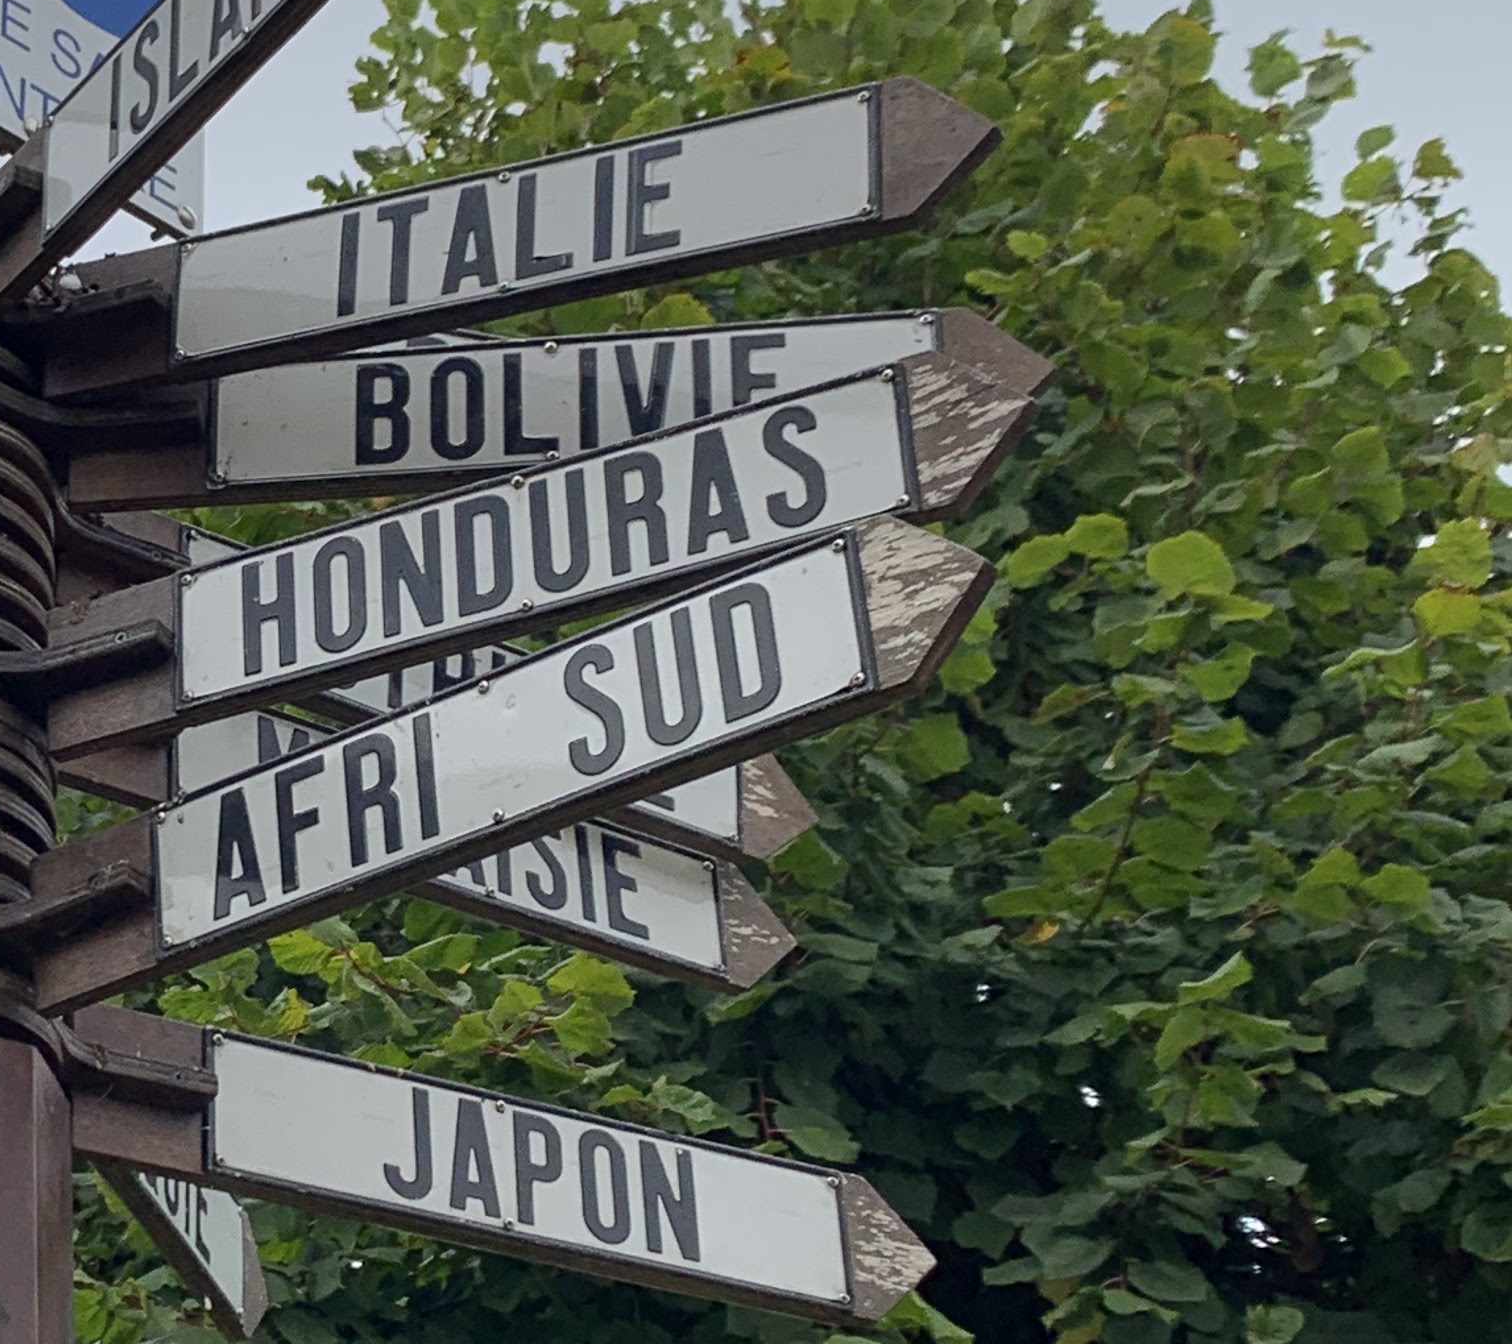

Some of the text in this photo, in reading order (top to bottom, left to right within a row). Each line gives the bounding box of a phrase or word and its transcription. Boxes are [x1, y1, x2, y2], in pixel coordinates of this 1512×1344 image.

[337, 140, 682, 317] ITALIE
[241, 405, 828, 677] HONDURAS
[213, 582, 781, 920] AFRI SUD
[384, 1086, 701, 1264] JAPON
